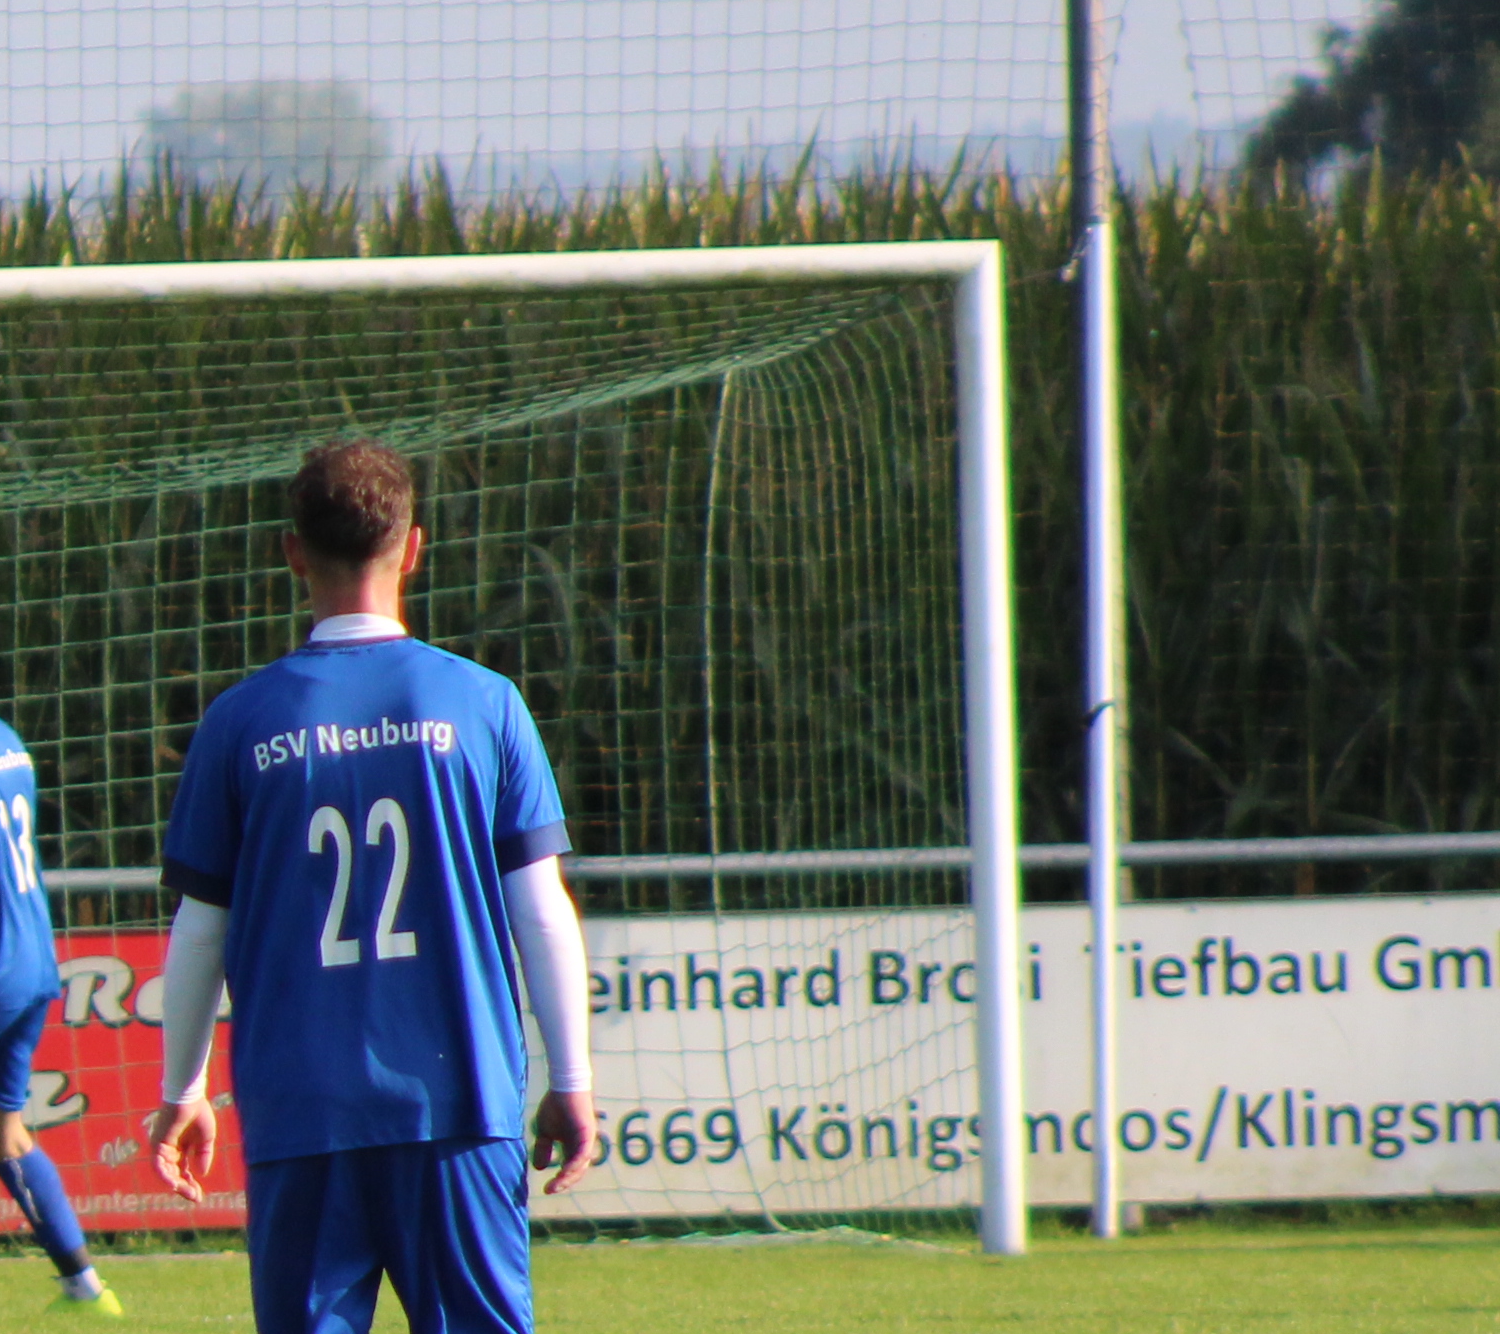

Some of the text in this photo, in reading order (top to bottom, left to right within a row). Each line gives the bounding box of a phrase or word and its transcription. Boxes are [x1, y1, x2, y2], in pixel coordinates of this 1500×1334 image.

[254, 717, 453, 771] BSV Neuburg
[308, 797, 417, 967] 22
[590, 950, 840, 1013] einhard
[1084, 936, 1347, 998] iefbau
[1375, 935, 1497, 992] Gm
